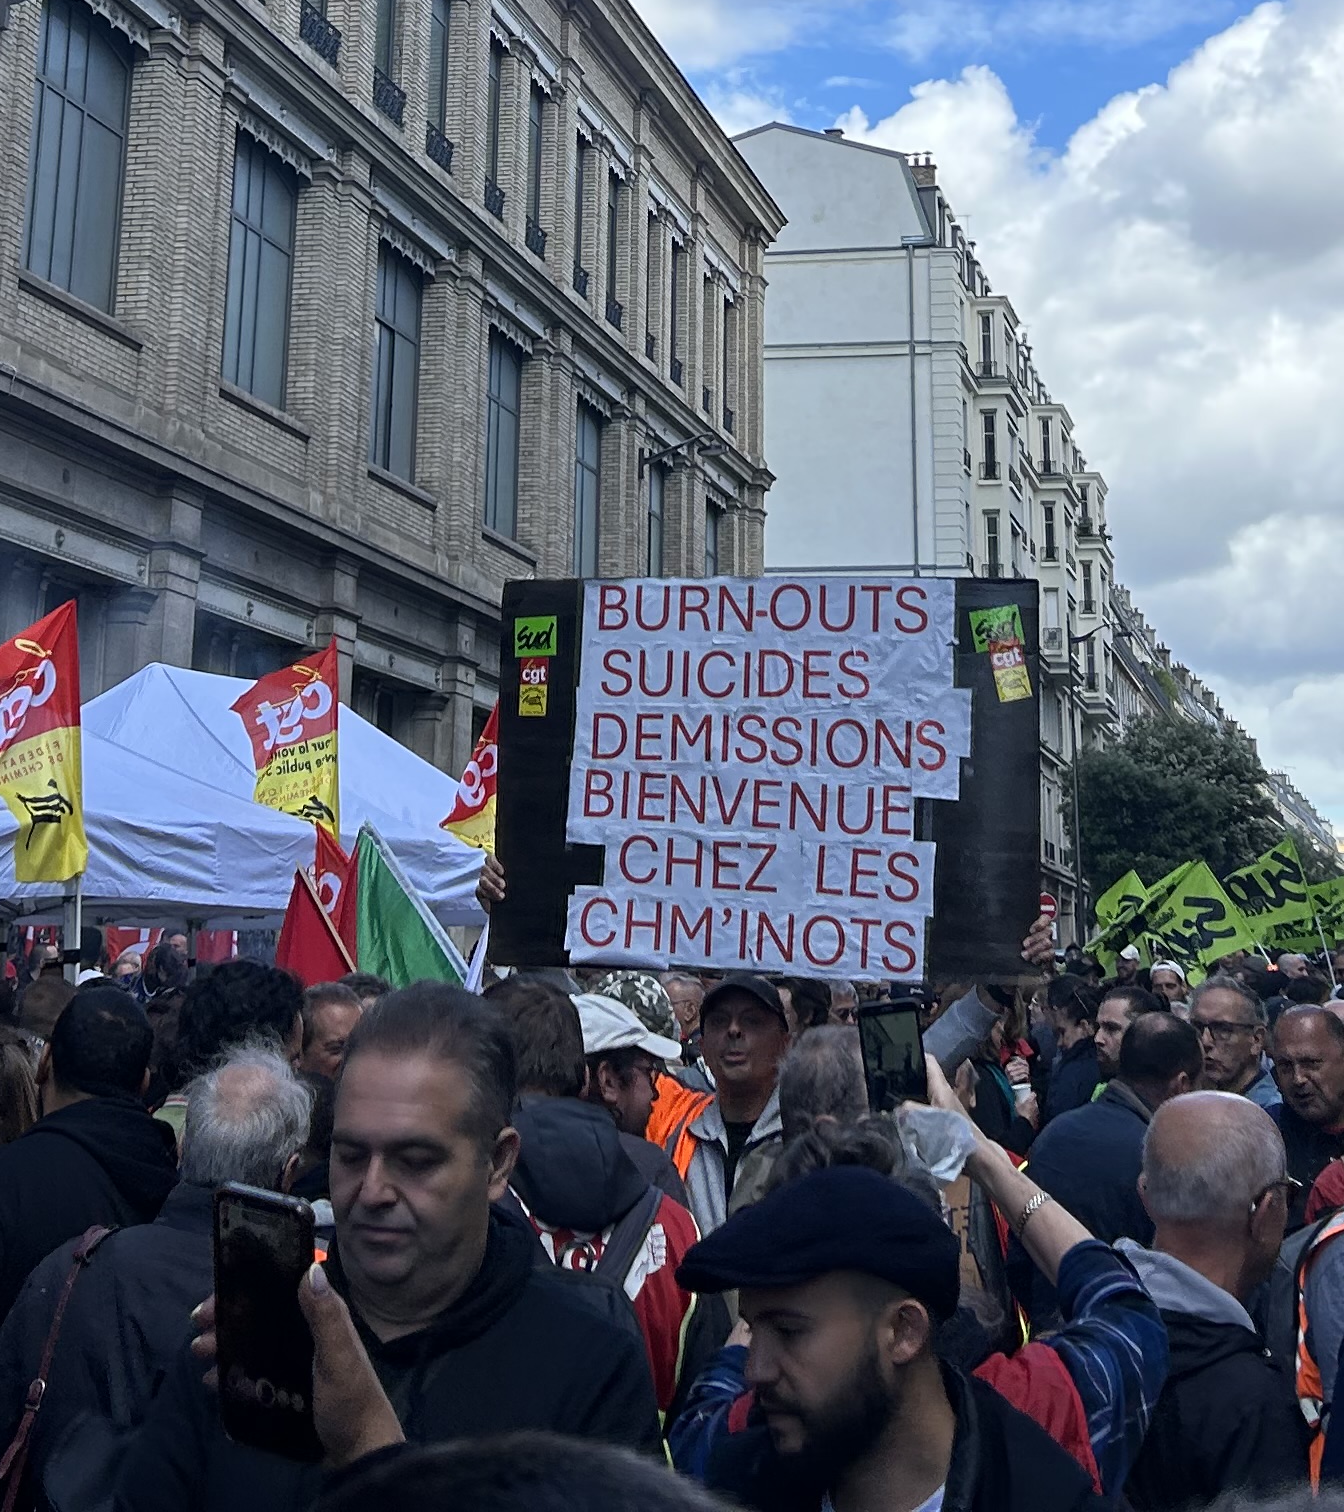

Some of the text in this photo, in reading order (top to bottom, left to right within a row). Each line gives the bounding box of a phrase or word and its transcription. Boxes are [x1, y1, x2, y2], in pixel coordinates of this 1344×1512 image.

[598, 583, 928, 634] BURN-OUTS
[522, 666, 546, 684] cgt
[601, 649, 871, 699] SUICIDES
[591, 712, 947, 771] DEMISSIONS
[582, 769, 913, 836] BIENVENUE
[619, 835, 920, 903] CHEZ LES
